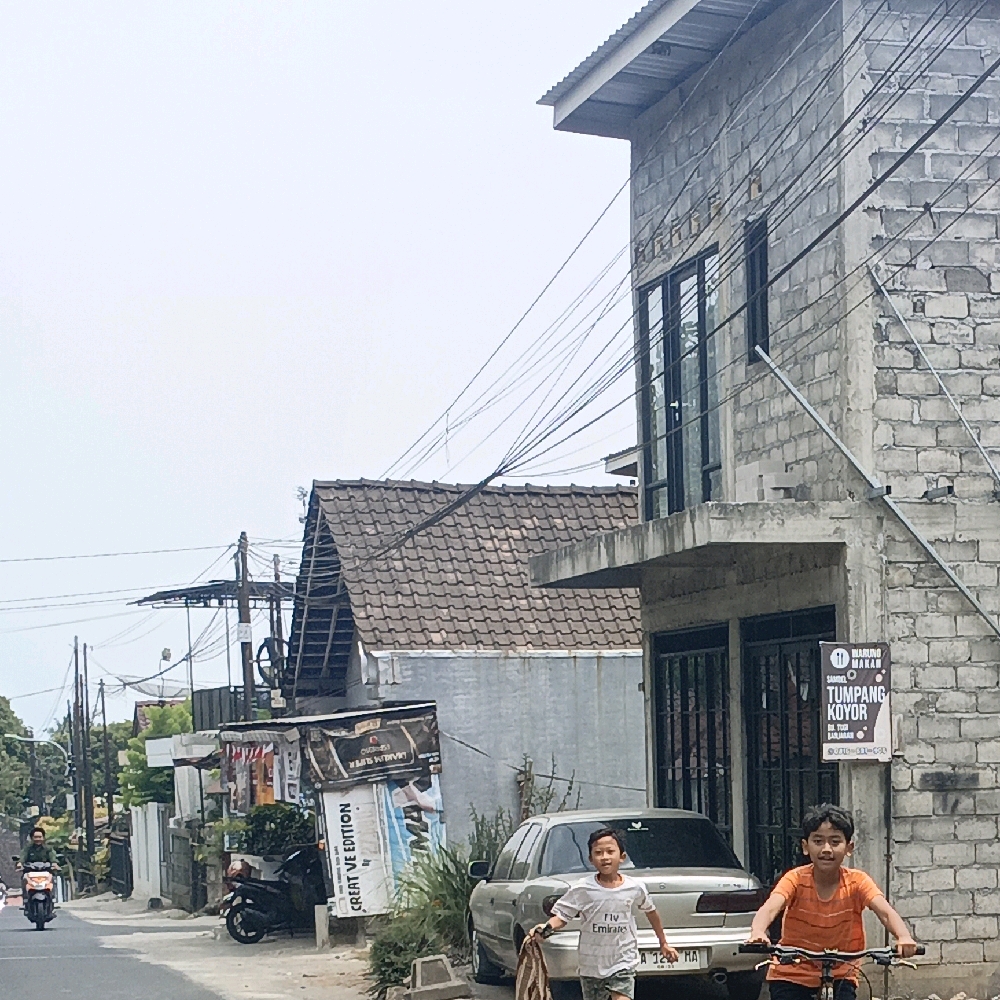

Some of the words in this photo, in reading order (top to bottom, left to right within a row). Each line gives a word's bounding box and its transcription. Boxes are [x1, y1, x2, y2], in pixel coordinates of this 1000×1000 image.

[826, 686, 886, 704] TUMPANG
[827, 703, 868, 721] KOYOR
[339, 802, 356, 852] EDITION
[344, 854, 363, 912] CREATVE
[604, 913, 620, 922] Fly
[592, 923, 628, 934] Emirates
